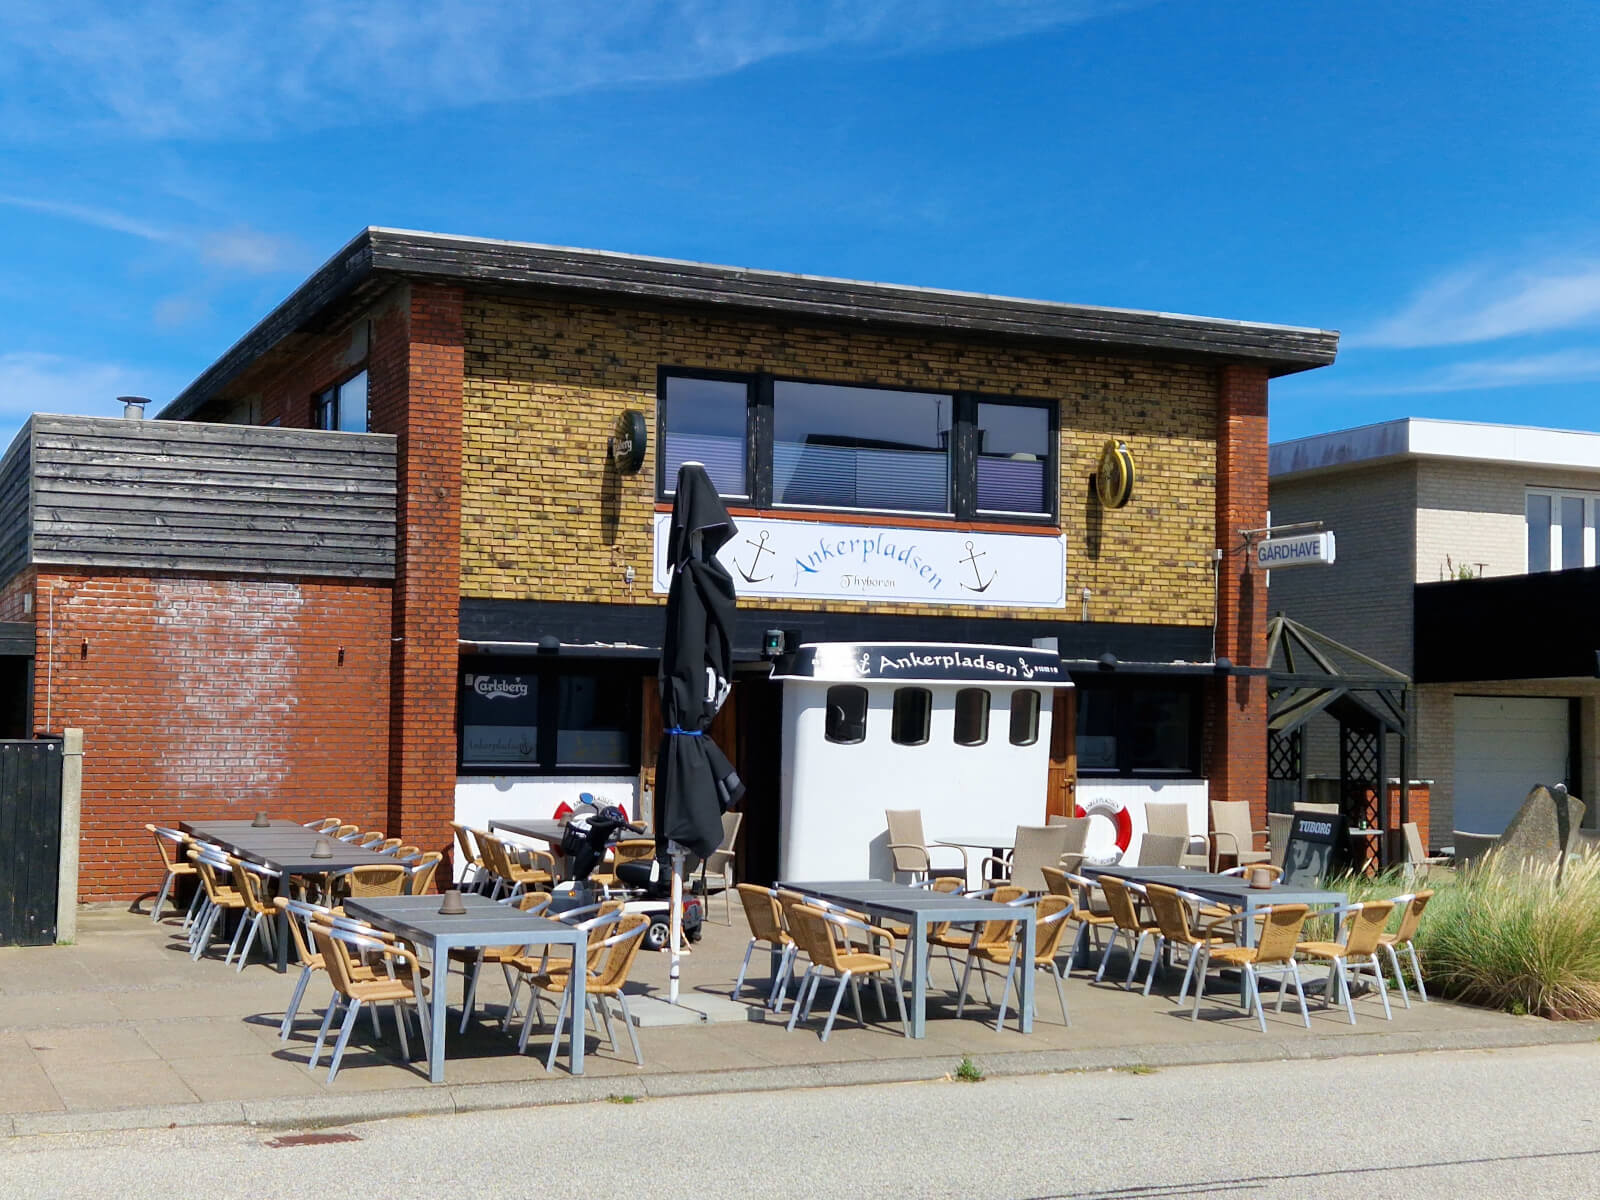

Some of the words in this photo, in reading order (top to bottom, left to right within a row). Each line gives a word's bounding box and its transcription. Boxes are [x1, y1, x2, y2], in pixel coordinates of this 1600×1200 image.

[794, 533, 943, 590] Ankerpladsen
[879, 652, 1018, 676] Ankerpladsen
[474, 675, 528, 699] Carlsberg
[1298, 820, 1332, 835] TUBORG
